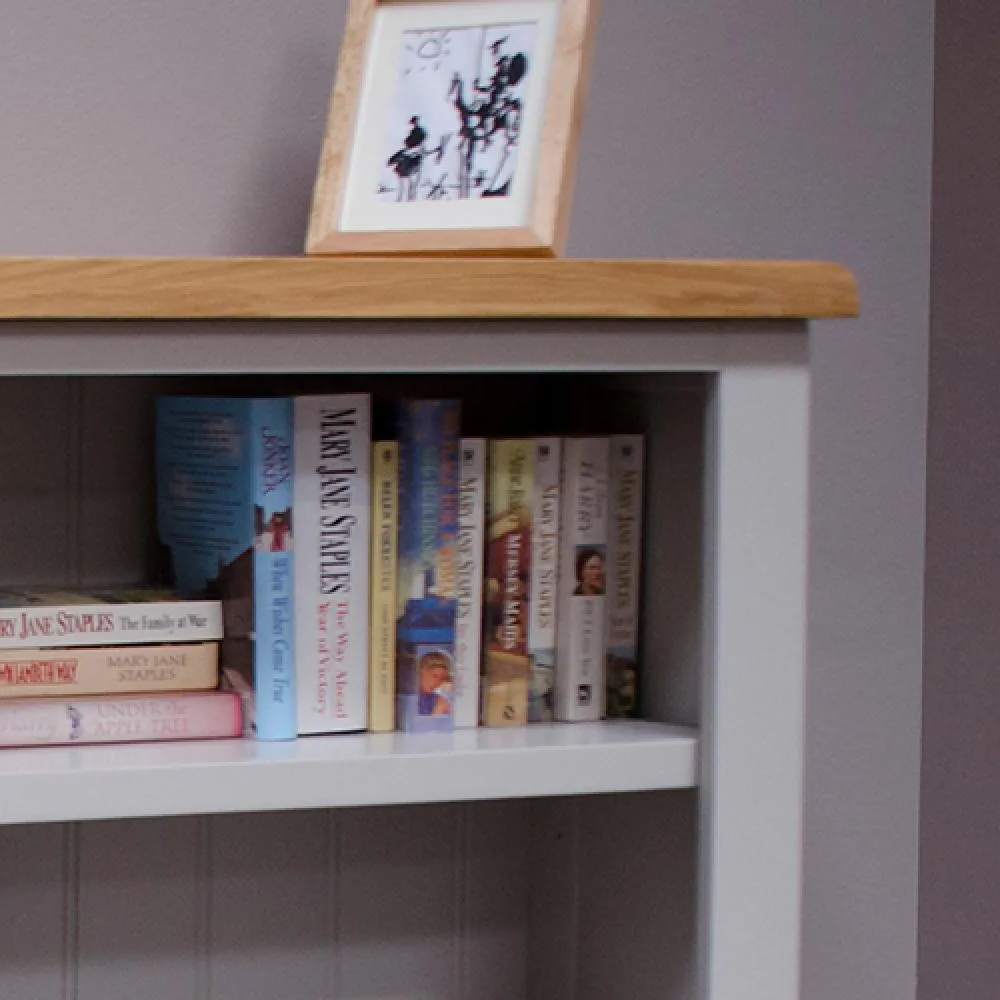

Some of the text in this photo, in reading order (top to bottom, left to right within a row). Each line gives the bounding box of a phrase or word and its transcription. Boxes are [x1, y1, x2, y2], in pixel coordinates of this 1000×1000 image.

[315, 407, 359, 596] MARY JANE STAPLES
[458, 478, 479, 519] MARY
[617, 469, 640, 512] MARY
[457, 522, 477, 558] JANE
[614, 515, 637, 547] JANE
[270, 556, 289, 592] When
[505, 534, 524, 596] MERSEY
[536, 486, 559, 629] MARY JANE STAPLES
[614, 551, 635, 609] STAPLES
[19, 612, 53, 639] JANE
[55, 611, 115, 636] STAPLES
[119, 614, 139, 632] The
[141, 613, 174, 634] Family
[504, 600, 522, 650] MAIDS
[107, 652, 188, 669] MARY JANE
[271, 639, 291, 672] Come
[314, 601, 334, 716] Year of Victory
[332, 601, 350, 719] The Way Ahead
[118, 668, 177, 683] STAPLES
[272, 677, 291, 705] True
[94, 720, 145, 736] APPLE
[97, 704, 162, 719] UNDER
